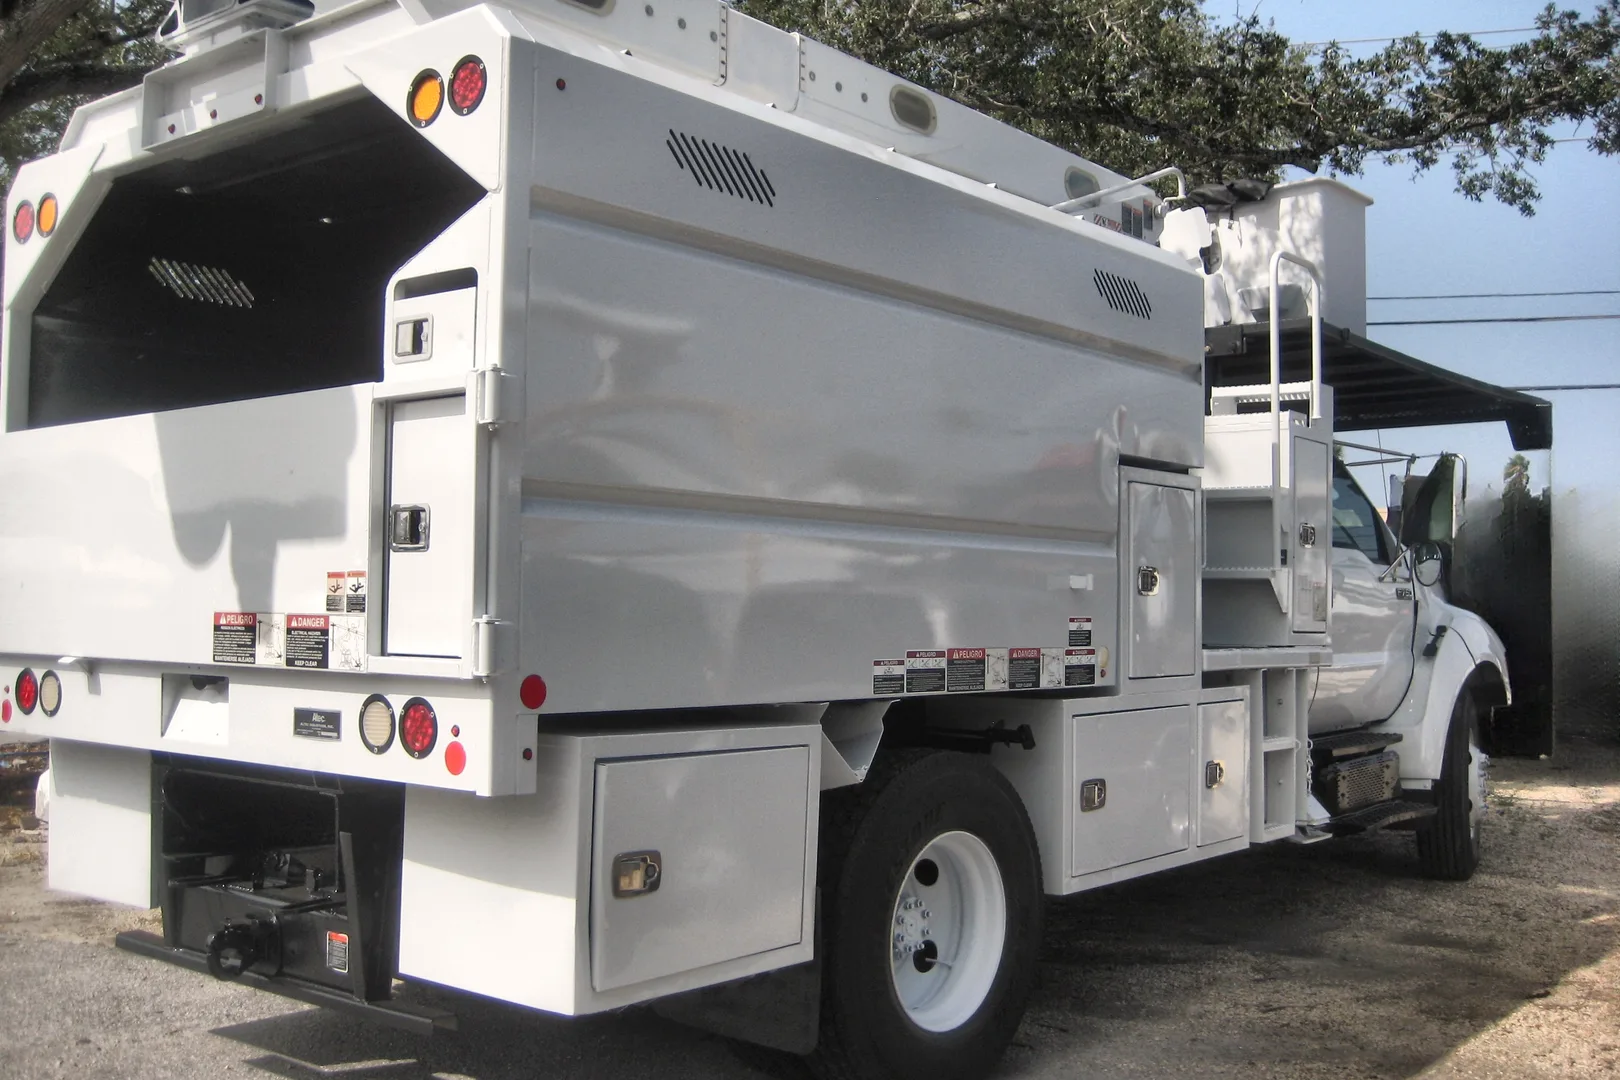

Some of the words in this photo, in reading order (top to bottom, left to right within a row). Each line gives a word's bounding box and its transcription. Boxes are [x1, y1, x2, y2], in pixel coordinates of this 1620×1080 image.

[226, 615, 254, 624] PELIGRO
[298, 618, 324, 627] DANGER
[959, 650, 983, 659] PELIGRO
[1017, 649, 1038, 658] DANGER
